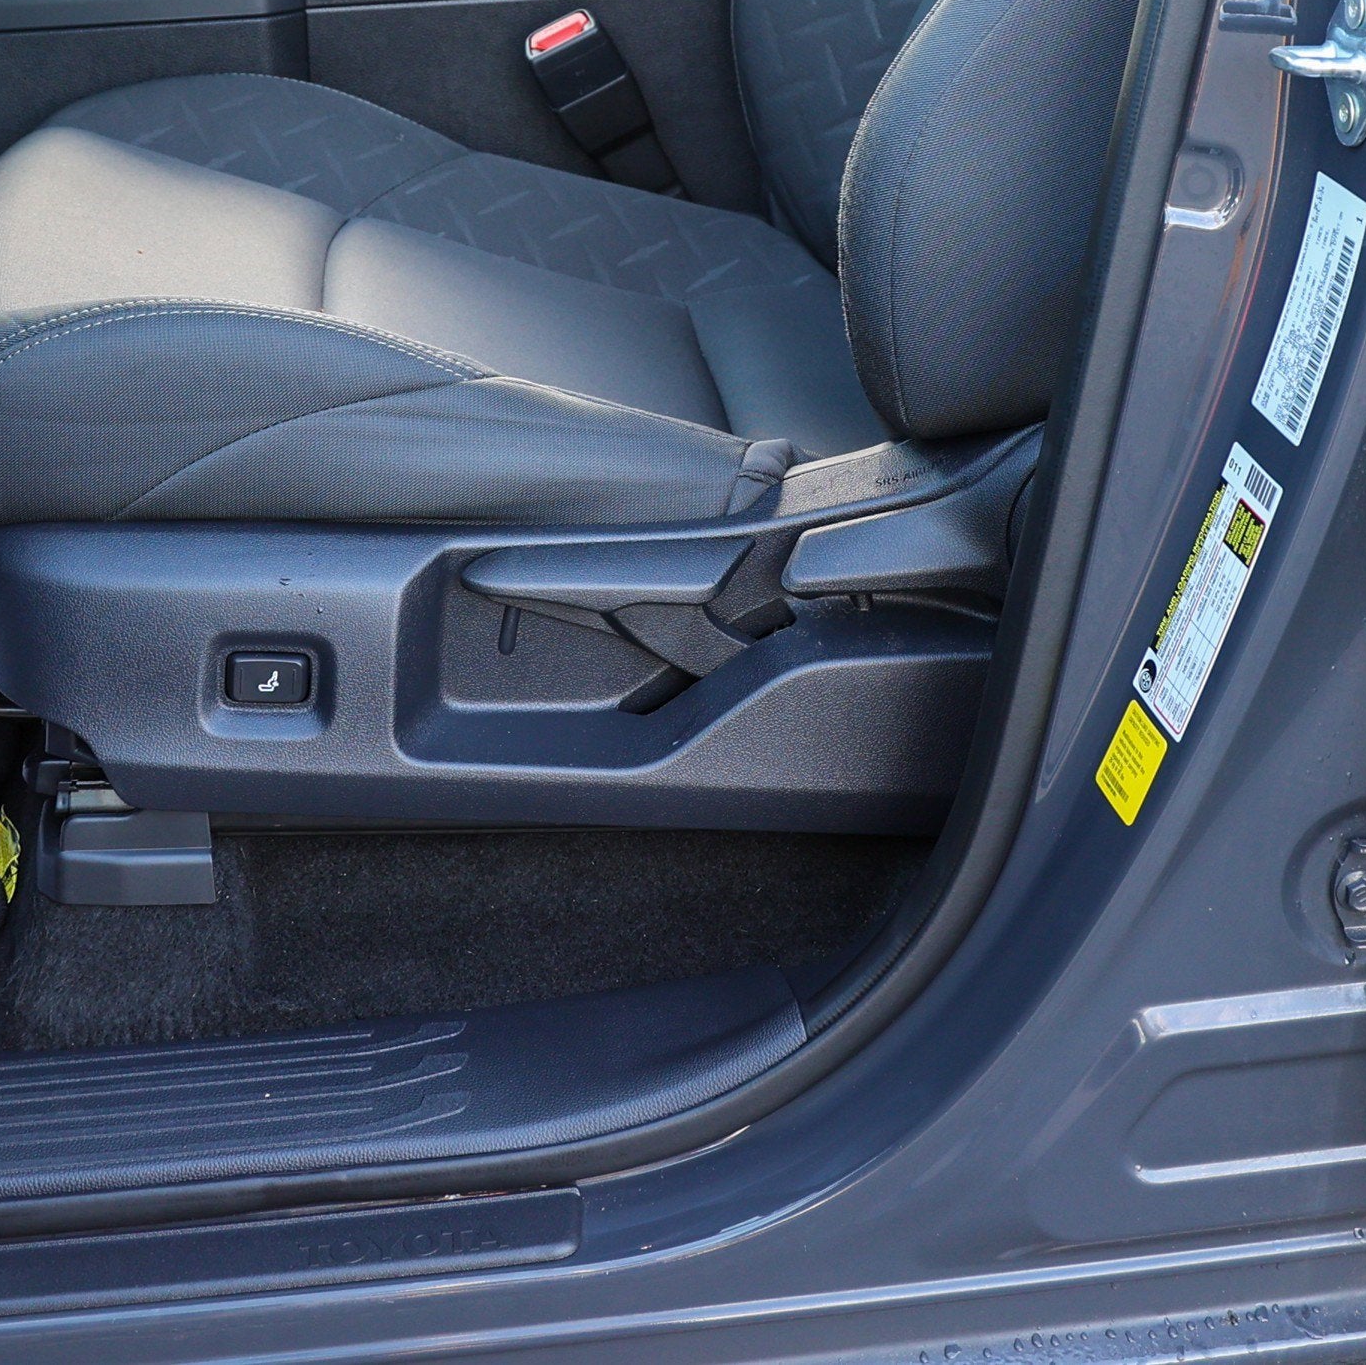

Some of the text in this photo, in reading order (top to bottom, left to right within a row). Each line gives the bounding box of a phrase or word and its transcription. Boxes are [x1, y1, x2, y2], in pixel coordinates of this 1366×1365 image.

[1227, 457, 1242, 475] 011
[1156, 615, 1168, 637] TIRE
[1166, 594, 1177, 615] AND
